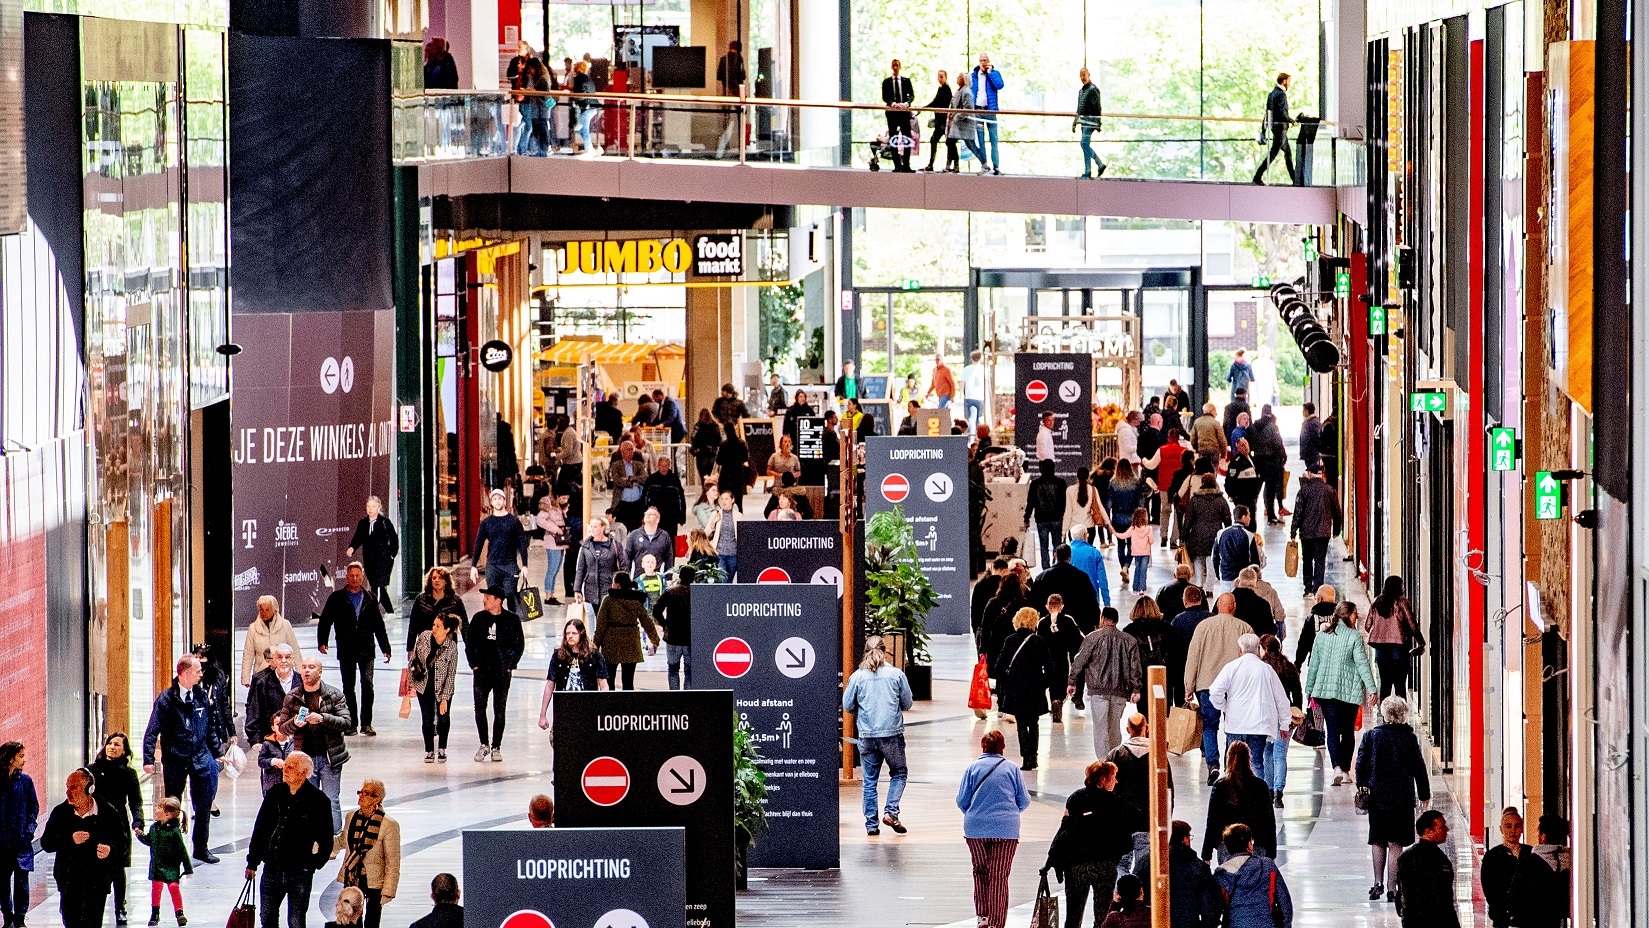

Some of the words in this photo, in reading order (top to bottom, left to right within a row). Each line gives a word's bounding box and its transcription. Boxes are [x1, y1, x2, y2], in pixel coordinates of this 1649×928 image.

[698, 236, 741, 259] food
[560, 240, 693, 274] JUMBO
[698, 258, 741, 274] markt
[1032, 362, 1075, 371] LOOPRICHTING
[744, 424, 774, 436] Jumbo
[234, 428, 257, 464] JE
[263, 427, 305, 463] DEZE
[310, 423, 365, 461] WINKELS
[367, 422, 377, 458] AL
[889, 448, 944, 460] LOOPRICHTING
[275, 525, 299, 541] SIEBEL
[767, 536, 834, 550] LOOPRICHTING
[284, 569, 319, 583] sandwich
[726, 602, 802, 617] LOOPRICHTING
[736, 699, 760, 707] Houd
[761, 699, 794, 707] afstand
[597, 714, 689, 731] LOOPRICHTING
[516, 858, 631, 880] LOOPRICHTING
[693, 903, 708, 911] zeep
